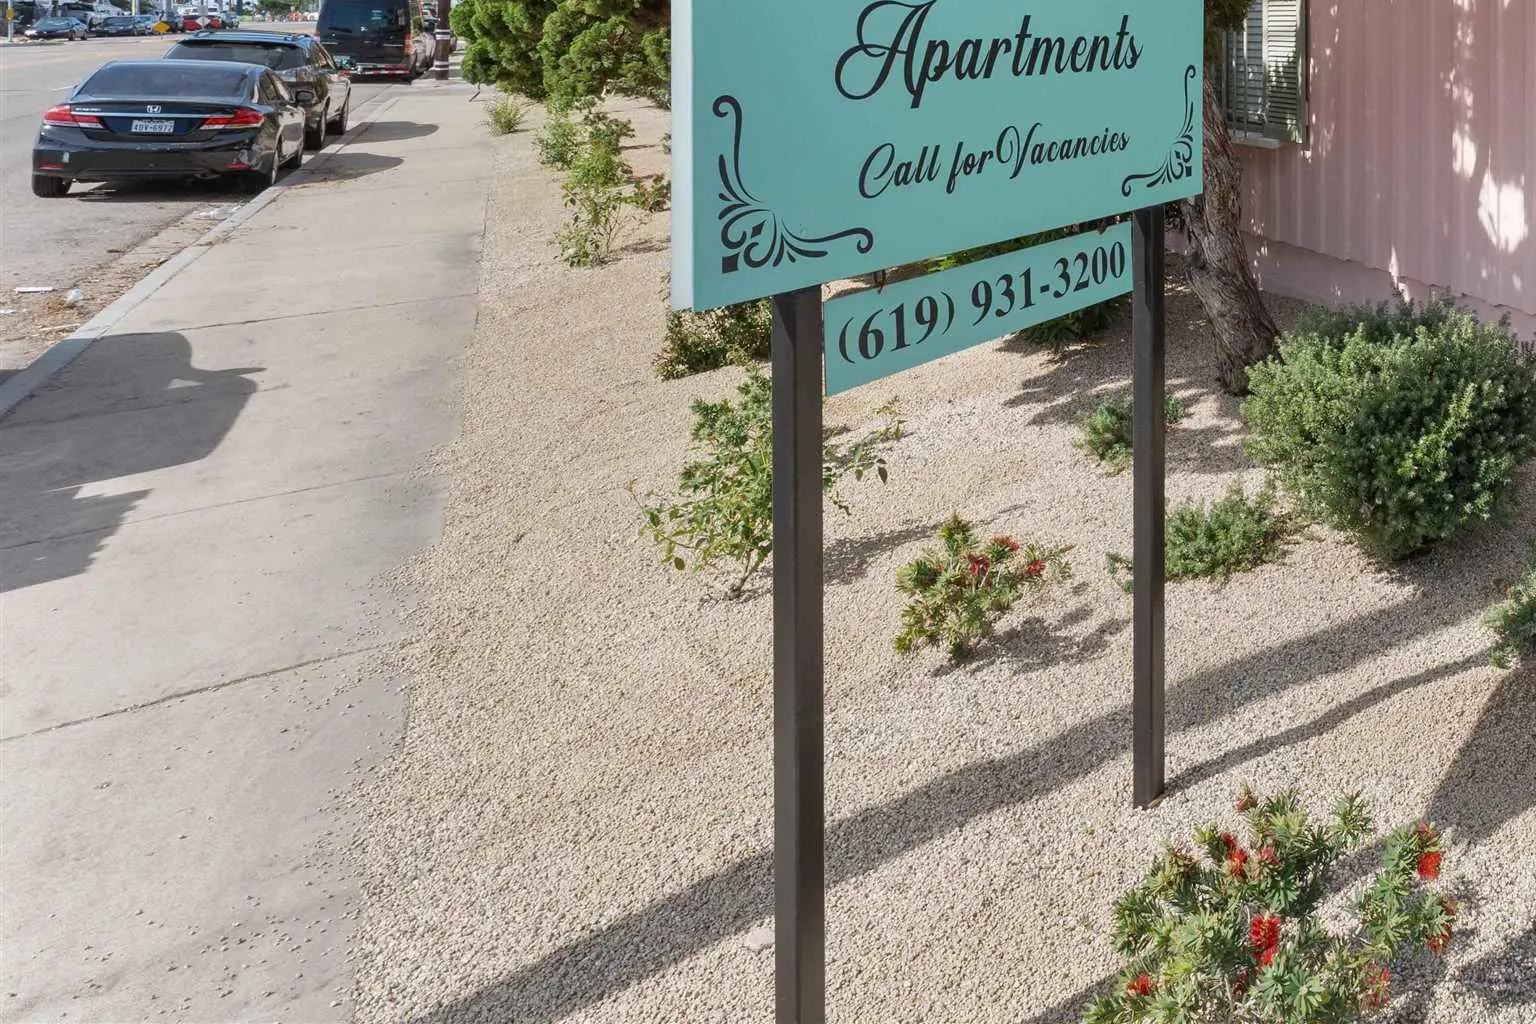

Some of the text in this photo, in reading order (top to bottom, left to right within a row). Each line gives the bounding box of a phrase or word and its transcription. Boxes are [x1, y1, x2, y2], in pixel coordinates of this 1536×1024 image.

[859, 122, 1130, 199] Call for Vacancies
[838, 241, 1125, 364] (619) 931-3200
